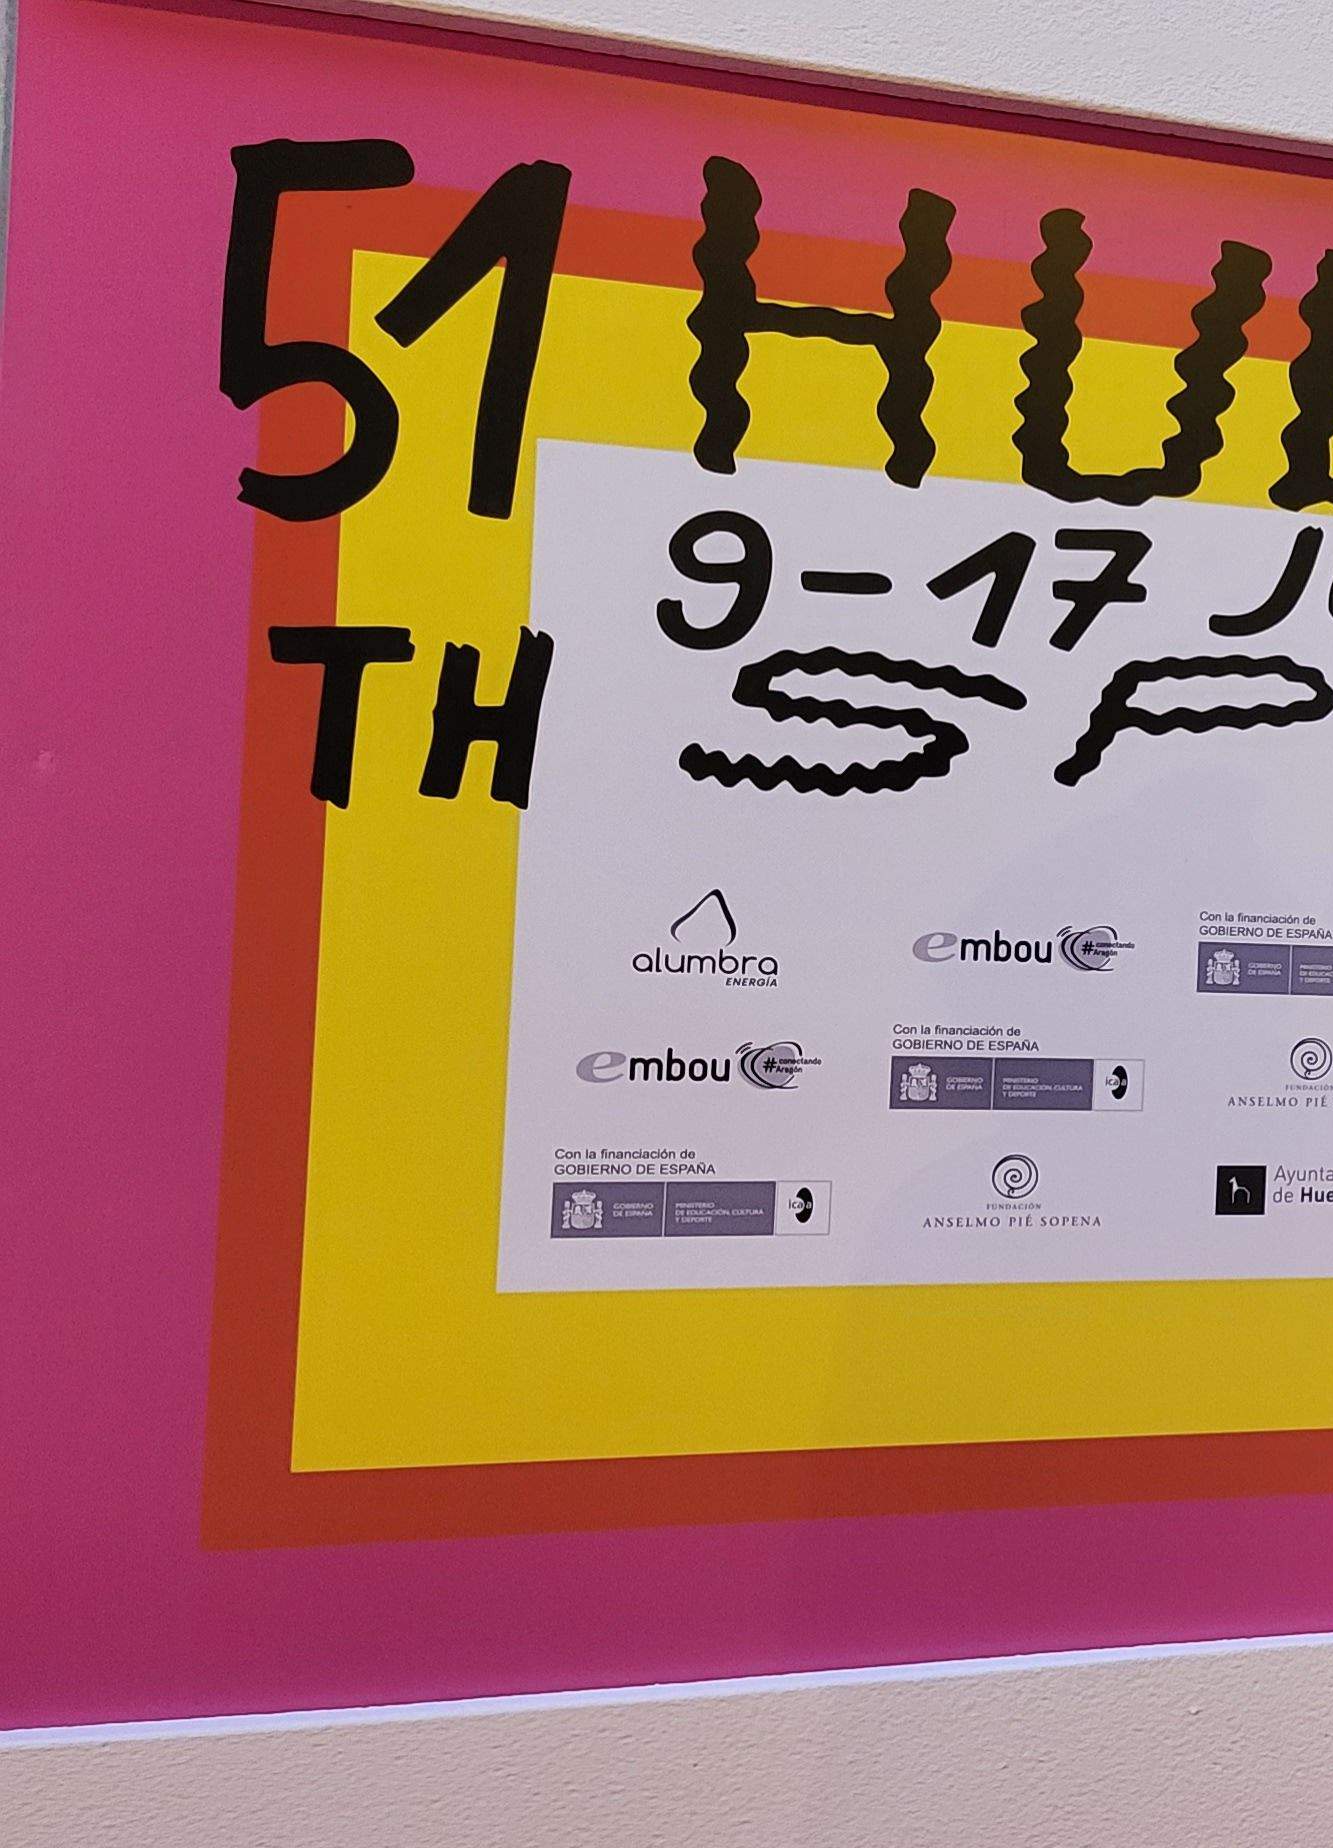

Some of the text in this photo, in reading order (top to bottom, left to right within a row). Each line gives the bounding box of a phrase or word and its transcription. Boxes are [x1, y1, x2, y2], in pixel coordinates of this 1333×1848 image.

[220, 138, 573, 523] 51
[268, 625, 555, 810] TH
[1199, 911, 1316, 926] Con la financiación de
[1199, 926, 1333, 940] GOBIERNO DE ESPAÑA
[912, 929, 1052, 963] embou
[632, 948, 779, 977] alumbra
[725, 976, 779, 988] ENERGÍA
[892, 1023, 1021, 1037] Con la financiación de
[892, 1038, 1040, 1052] GOBIERNO DE ESPAÑA
[576, 1047, 731, 1084] embou
[1227, 1096, 1299, 1107] ANSELMO
[1306, 1095, 1328, 1108] PIÉ
[554, 1148, 696, 1160] Con la financiación de
[554, 1161, 716, 1175] GOBIERNO DE ESPAÑA
[1272, 1187, 1294, 1204] de
[923, 1214, 1102, 1228] ANSELMO PIÉ SOPENA
